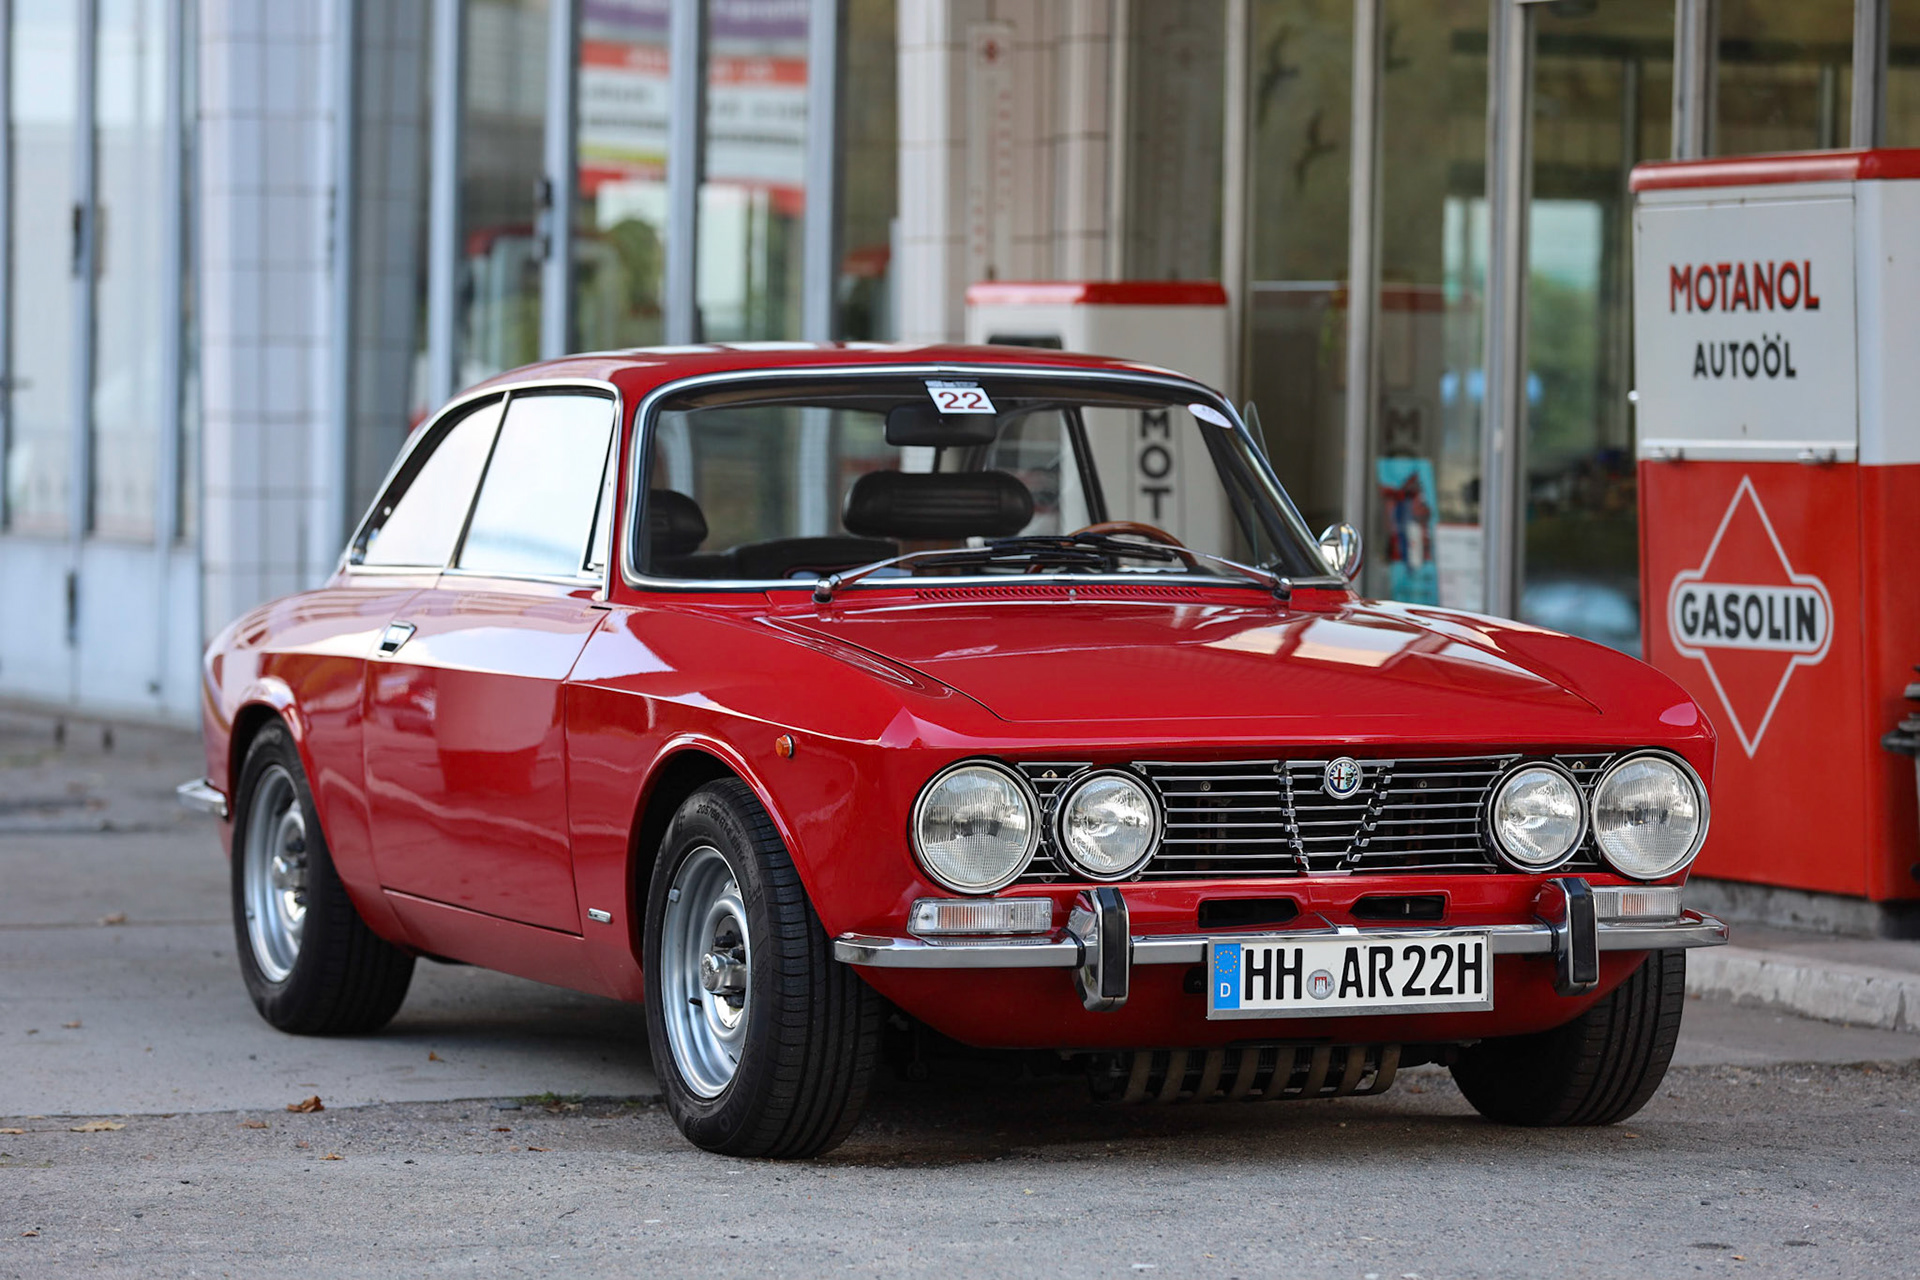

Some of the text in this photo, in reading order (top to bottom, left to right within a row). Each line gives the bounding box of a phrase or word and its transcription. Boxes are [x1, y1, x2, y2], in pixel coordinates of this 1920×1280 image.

[1670, 260, 1820, 313] MOTANOL
[1693, 332, 1797, 379] AUTOÖL
[938, 391, 989, 410] 22
[1681, 592, 1817, 643] GASOLIN
[1220, 982, 1231, 998] D
[1245, 948, 1303, 1000] HH
